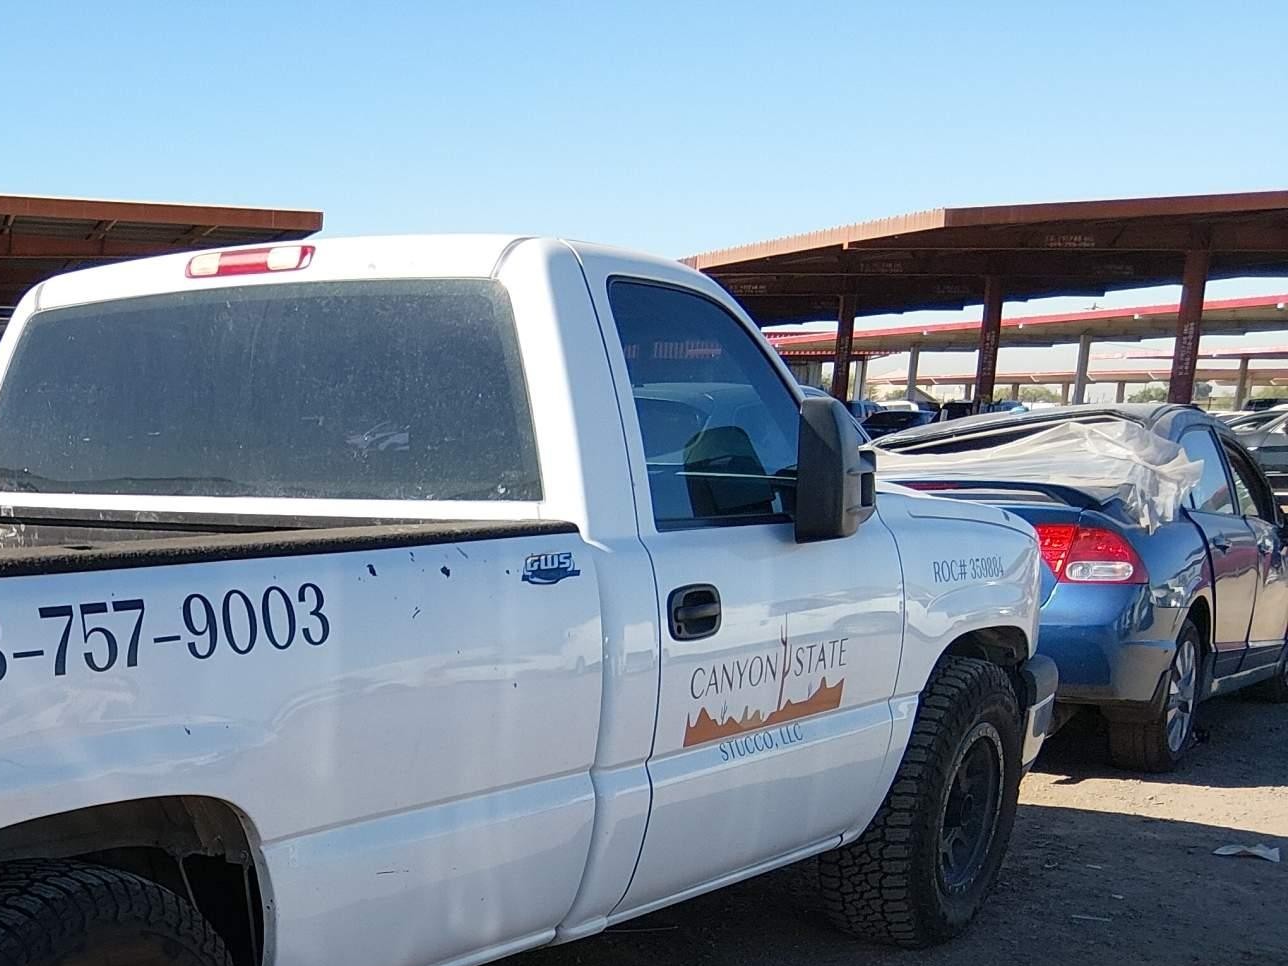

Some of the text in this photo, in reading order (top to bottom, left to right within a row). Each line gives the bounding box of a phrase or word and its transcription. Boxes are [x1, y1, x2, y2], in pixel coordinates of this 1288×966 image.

[933, 556, 1004, 583] ROC# 359884
[690, 638, 849, 699] CANYON STATE
[780, 722, 804, 745] LLC
